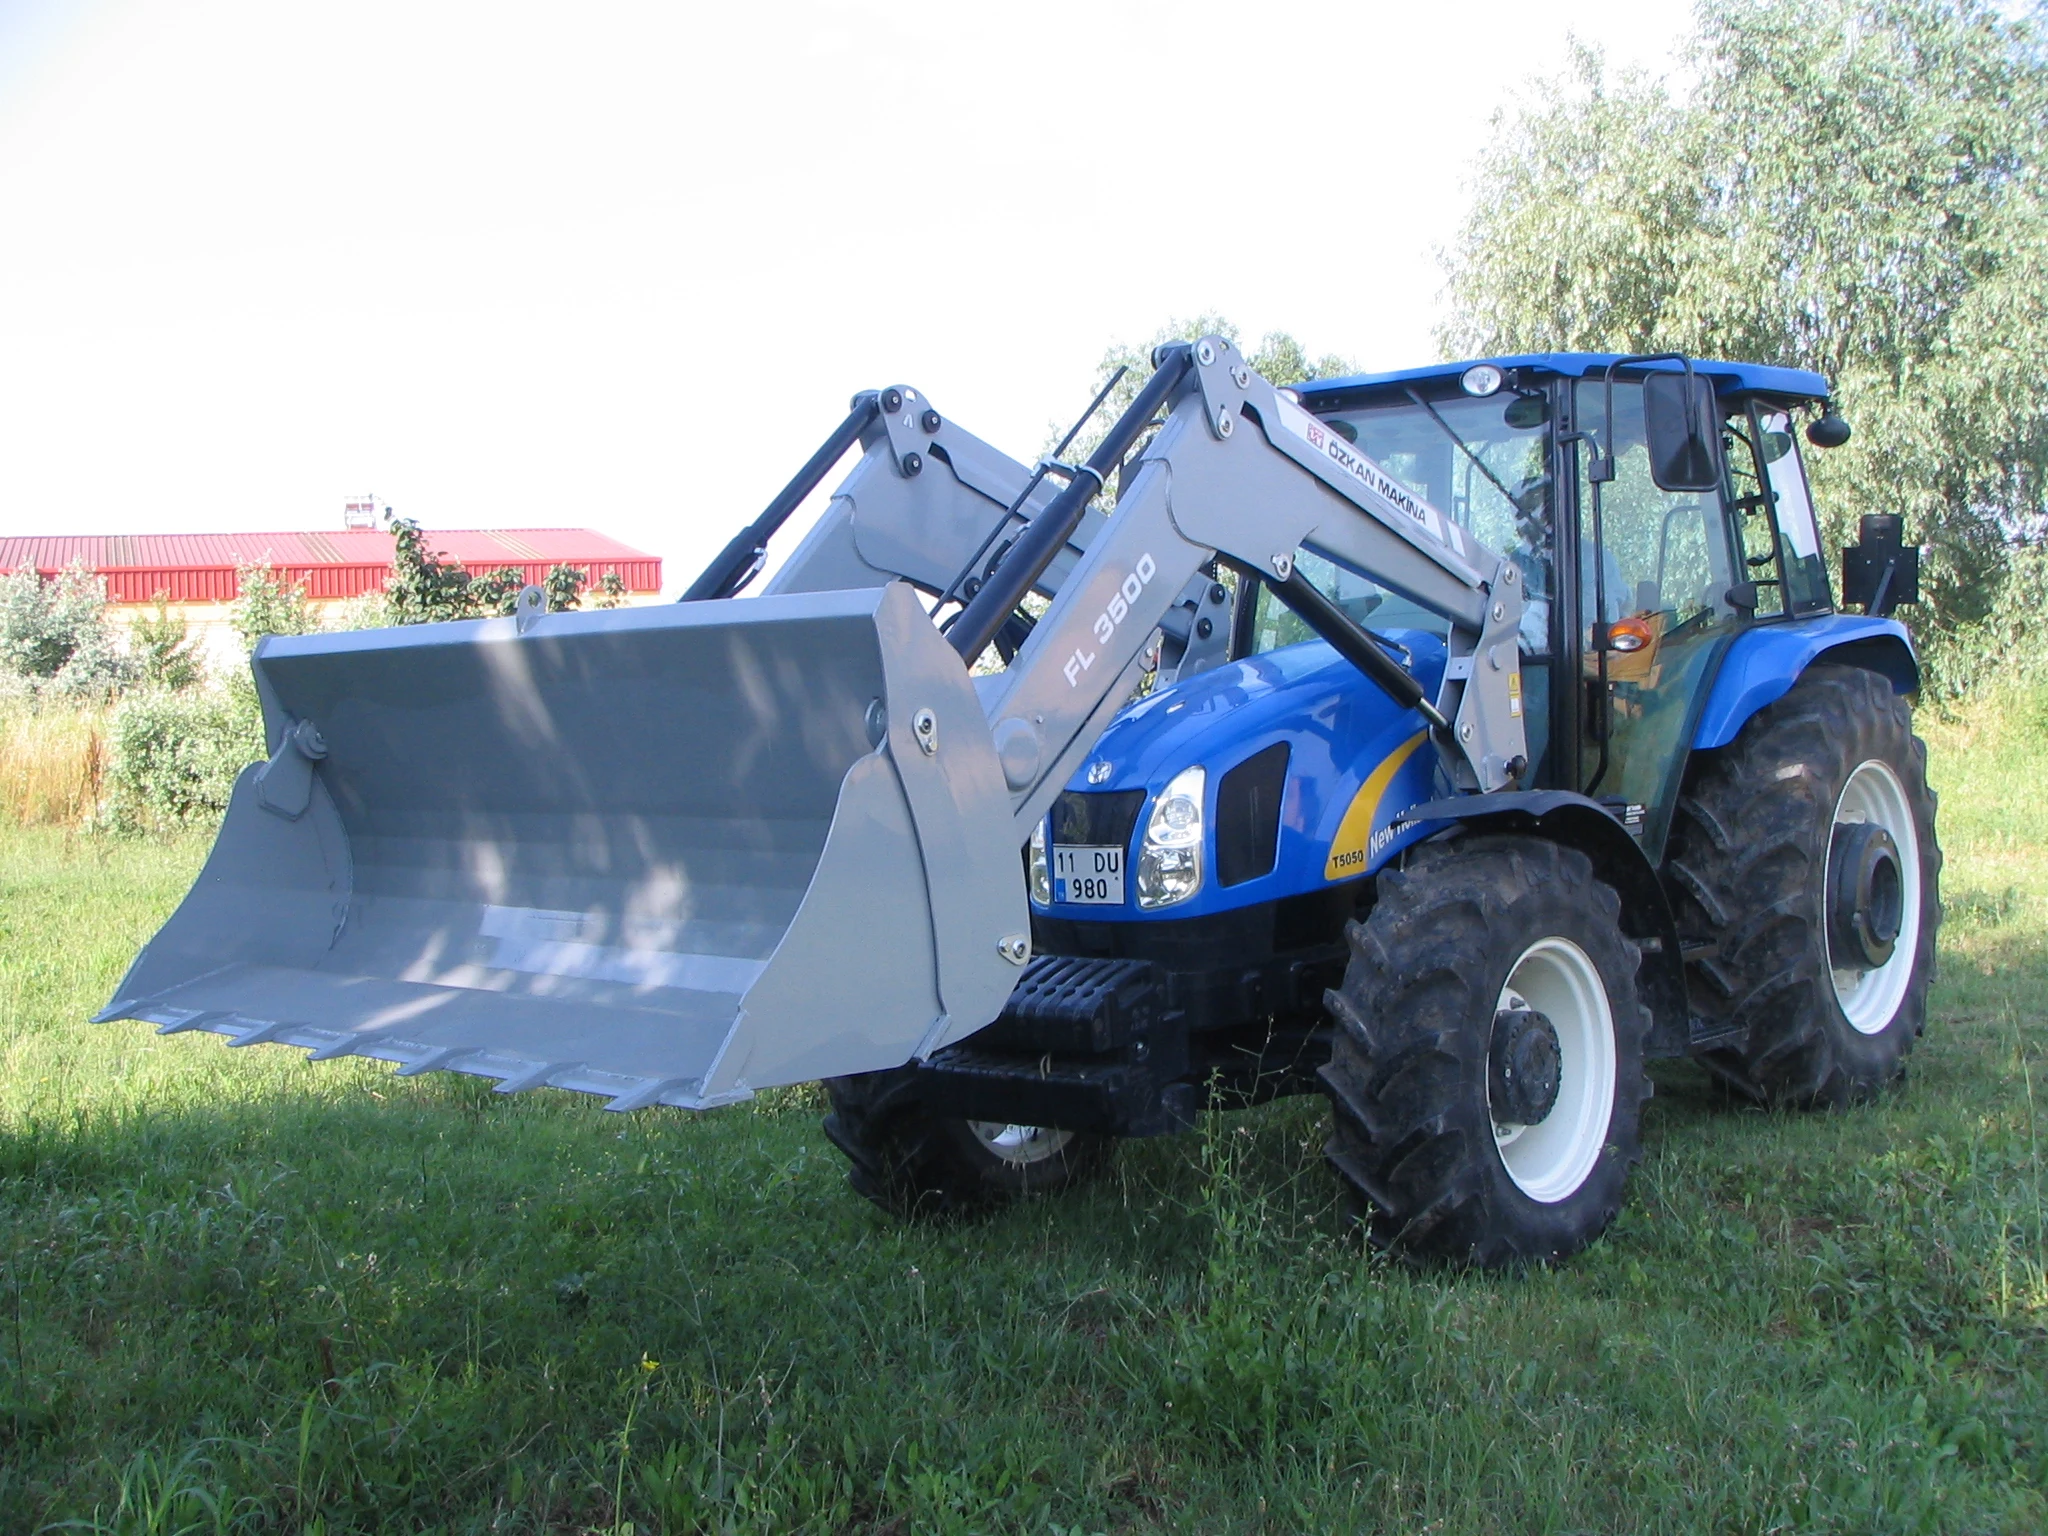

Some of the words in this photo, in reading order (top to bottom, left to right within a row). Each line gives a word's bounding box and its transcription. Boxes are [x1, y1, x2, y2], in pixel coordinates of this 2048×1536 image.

[1328, 440, 1376, 487] ÖZKAN
[1377, 478, 1427, 526] MAKİNA
[1063, 648, 1096, 688] FL
[1093, 552, 1156, 645] 3500
[1369, 825, 1395, 859] New
[1058, 852, 1074, 873] 11
[1094, 852, 1119, 873] DU
[1331, 849, 1364, 869] T5050
[1072, 878, 1107, 899] 980
